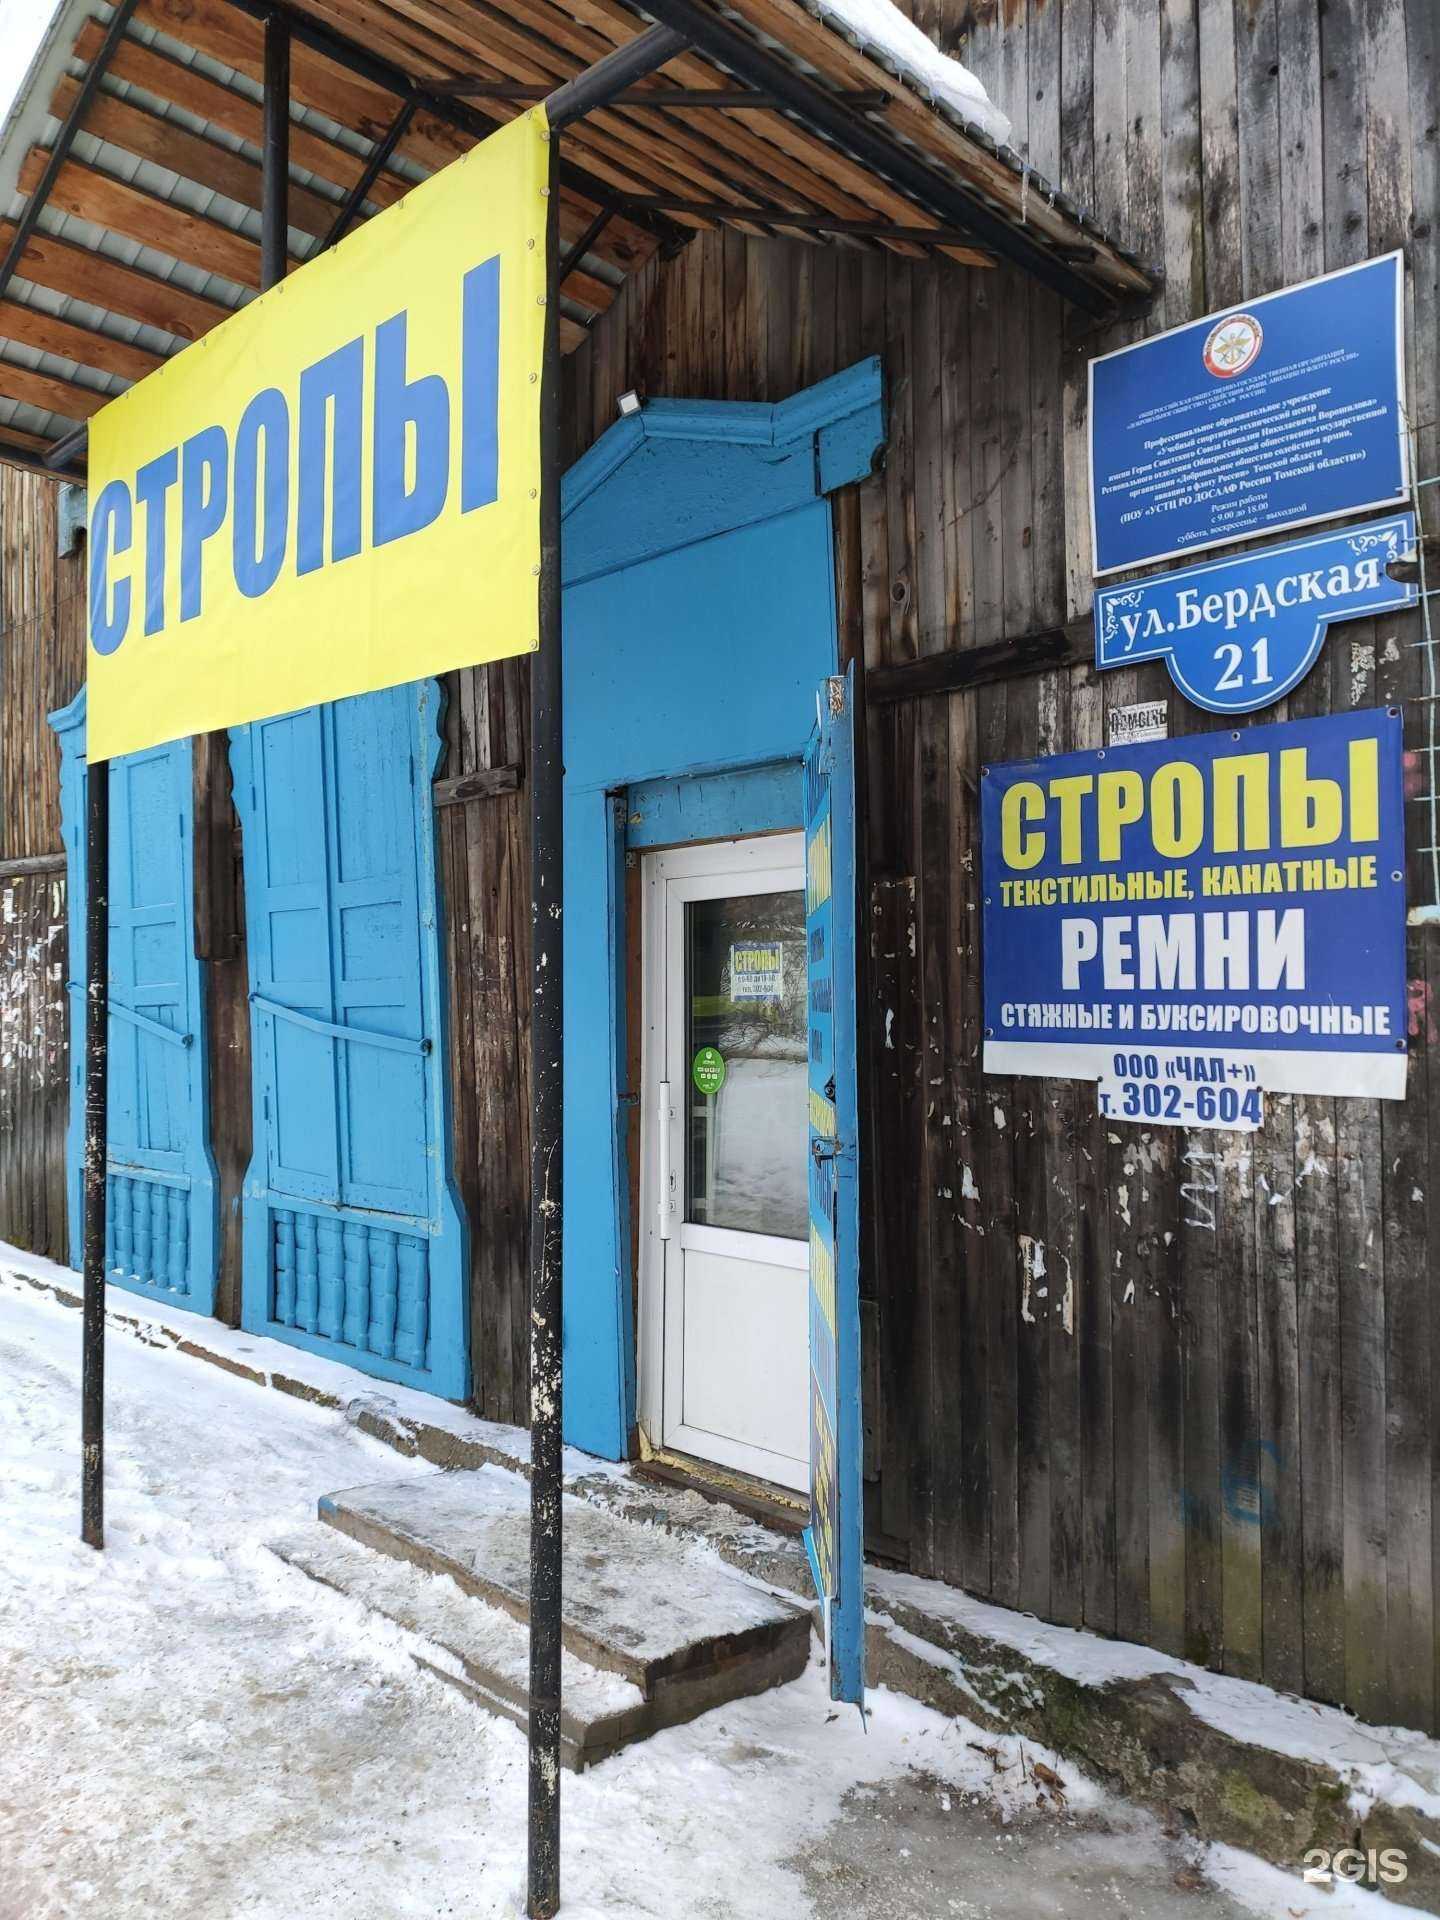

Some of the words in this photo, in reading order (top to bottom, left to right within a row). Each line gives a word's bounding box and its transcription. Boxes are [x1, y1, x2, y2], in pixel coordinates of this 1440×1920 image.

[90, 254, 500, 656] СТРОПЫ
[1120, 508, 1142, 524] (ПОУ
[1144, 498, 1177, 516] «УСТЦ
[1178, 494, 1192, 507] РО
[1193, 482, 1237, 503] ДОСААФ
[1239, 473, 1271, 490] России
[1273, 461, 1314, 481] Томской
[1316, 447, 1366, 470] области»)
[1211, 499, 1237, 512] Режим
[1238, 491, 1267, 506] работы
[1216, 510, 1233, 521] 9.00
[1235, 508, 1245, 518] до
[1247, 501, 1268, 513] 18.00
[1177, 528, 1208, 544] суббота,
[1210, 517, 1257, 536] воскресенье
[1266, 504, 1306, 520] выходной
[1121, 558, 1380, 650] ул.Бердская
[1213, 637, 1273, 692] 21
[1001, 738, 1379, 870] СТРОПЫ
[1000, 869, 1194, 908] ТЕКСТИЛЬНЫЕ,
[1202, 855, 1378, 897] КАНАТНЫЕ
[1061, 908, 1305, 990] РЕМНИ
[1000, 1002, 1113, 1030] СТЯЖНЫЕ
[1118, 1005, 1134, 1030] И
[1140, 1004, 1391, 1036] БУКСИРОВОЧНЫЕ
[1164, 1054, 1256, 1083] «ЧАЛ+»
[1099, 1094, 1116, 1115] т.
[1122, 1083, 1262, 1124] 302-604
